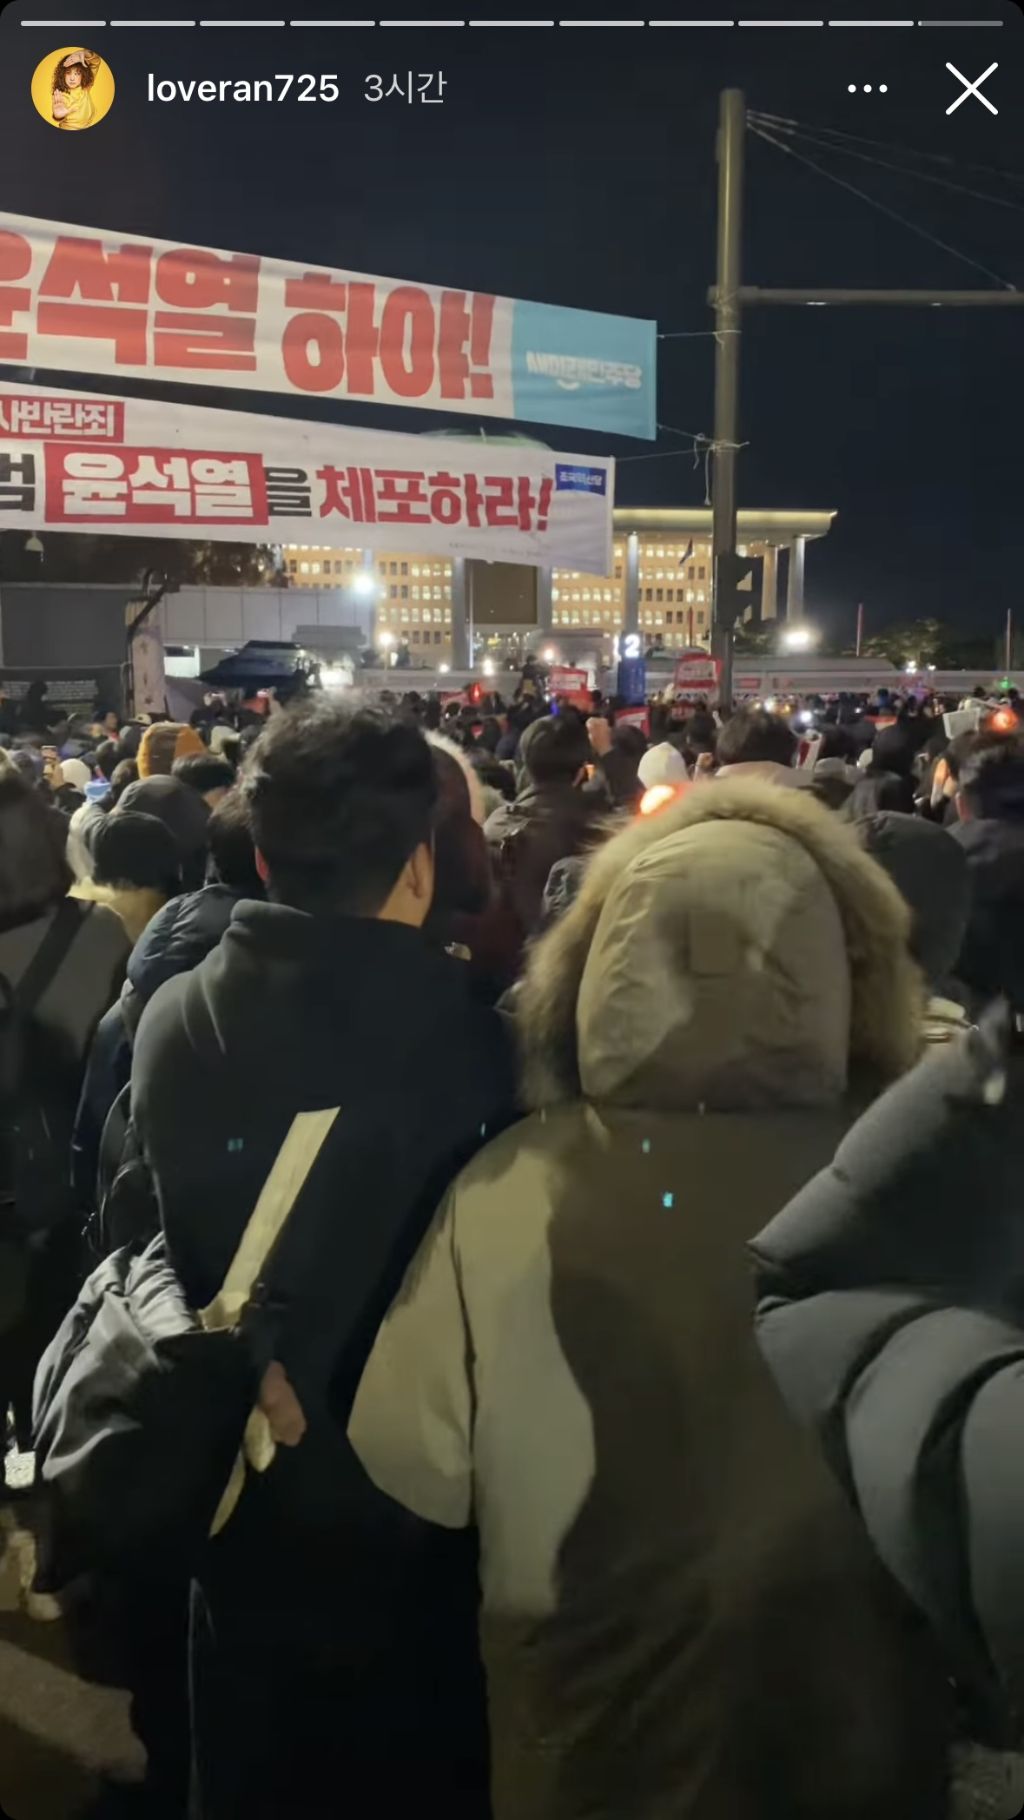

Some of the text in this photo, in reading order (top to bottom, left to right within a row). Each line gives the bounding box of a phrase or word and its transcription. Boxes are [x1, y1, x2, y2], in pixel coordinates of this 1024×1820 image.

[281, 271, 496, 400] 하야!
[316, 465, 553, 532] 체포하라!
[624, 633, 640, 658] 2
